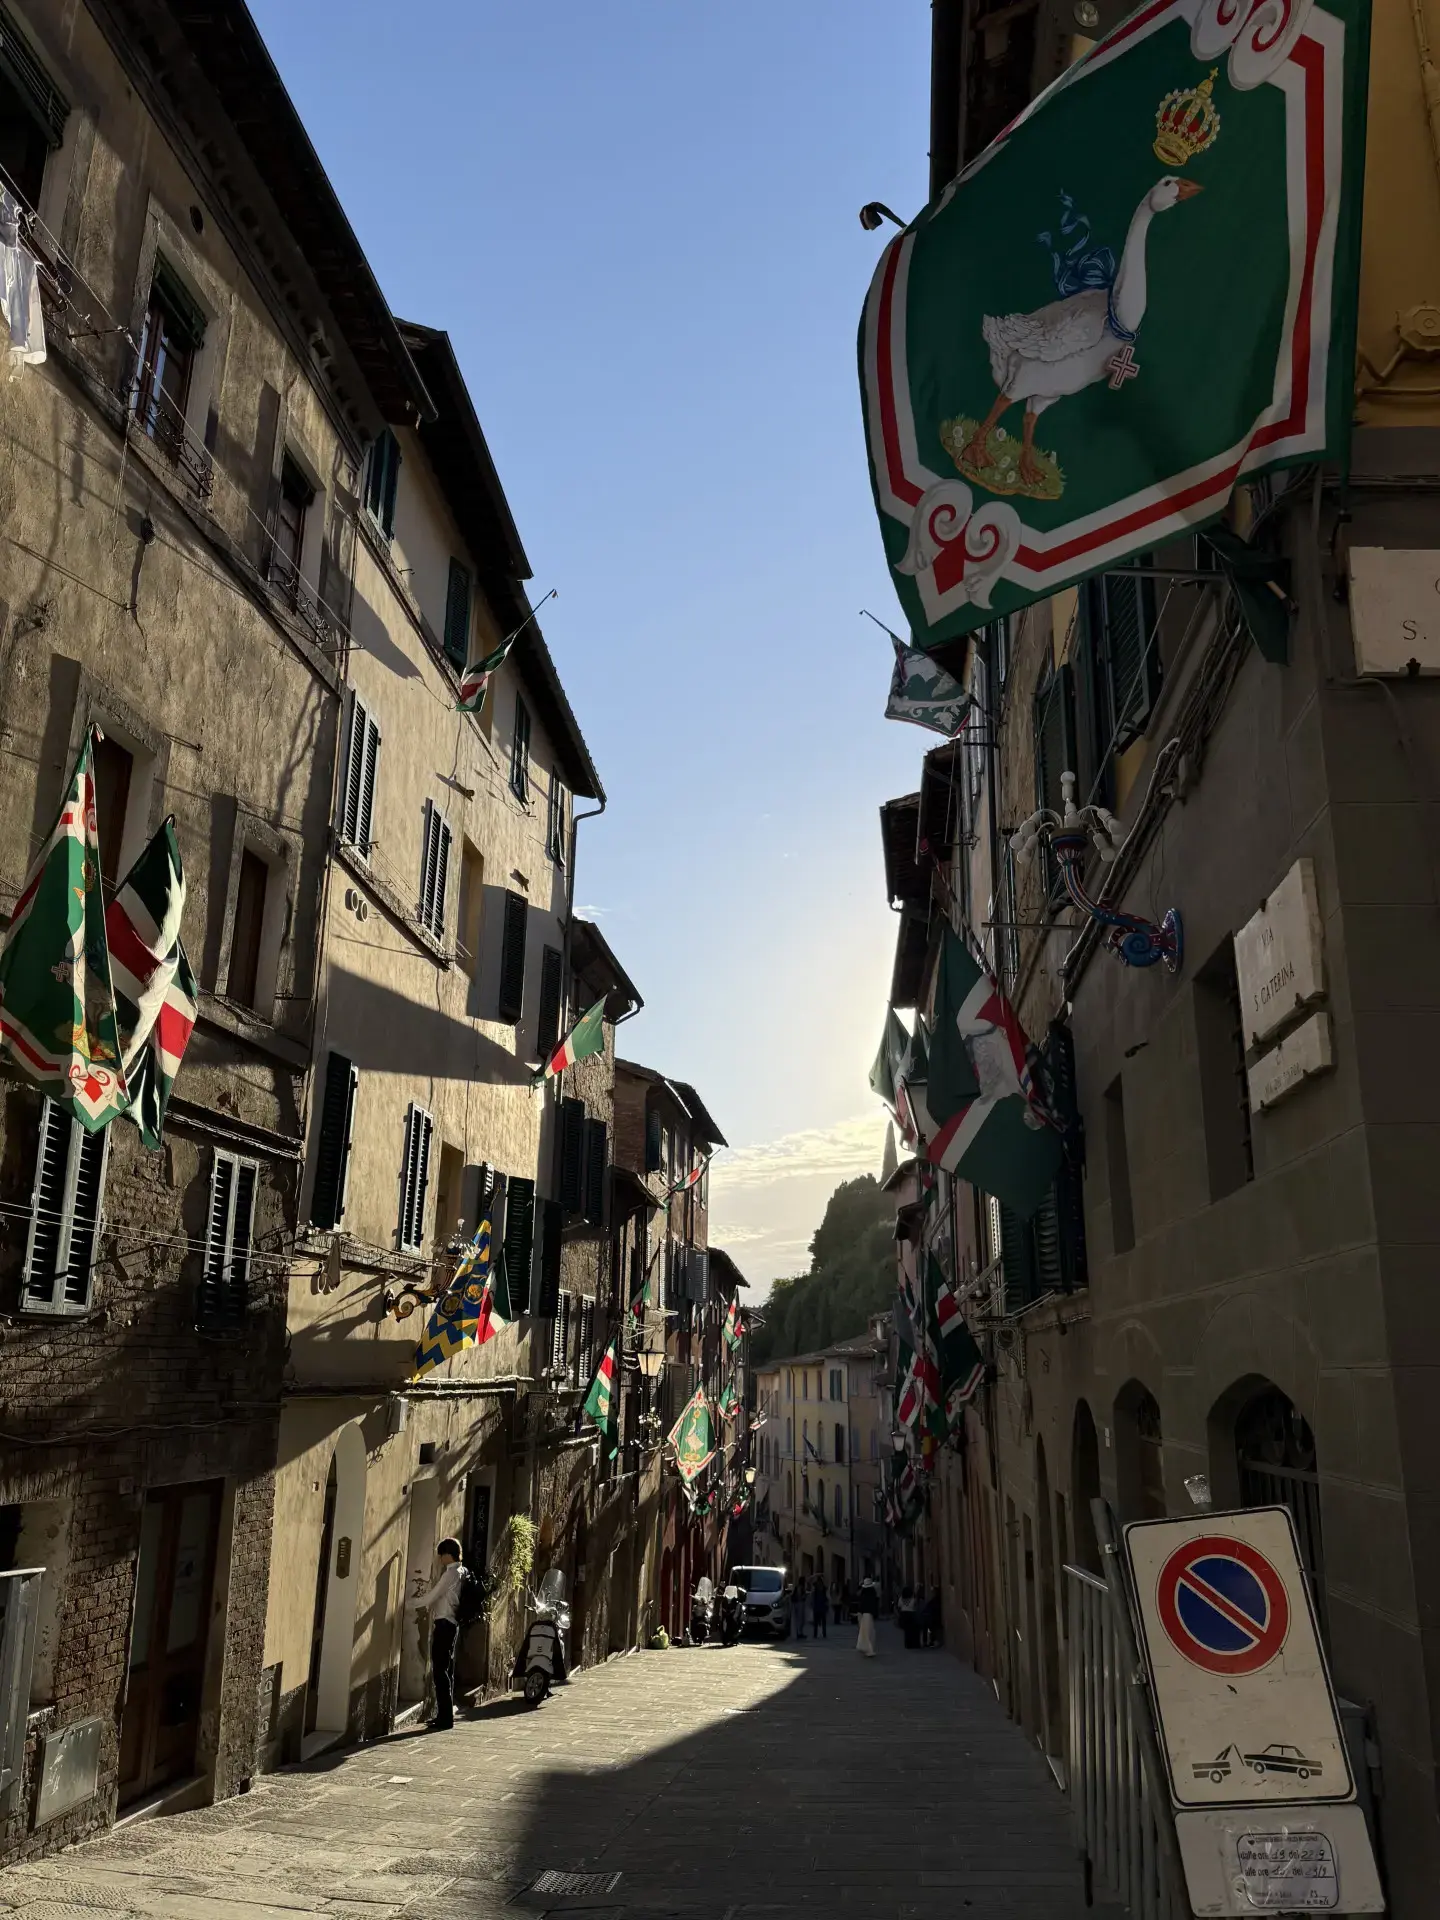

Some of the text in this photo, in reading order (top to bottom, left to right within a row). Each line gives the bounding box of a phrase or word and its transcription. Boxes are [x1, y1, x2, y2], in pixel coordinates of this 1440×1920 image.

[1261, 926, 1274, 946] VIA
[1261, 960, 1295, 1005] CATERINA
[1258, 1868, 1269, 1877] ore
